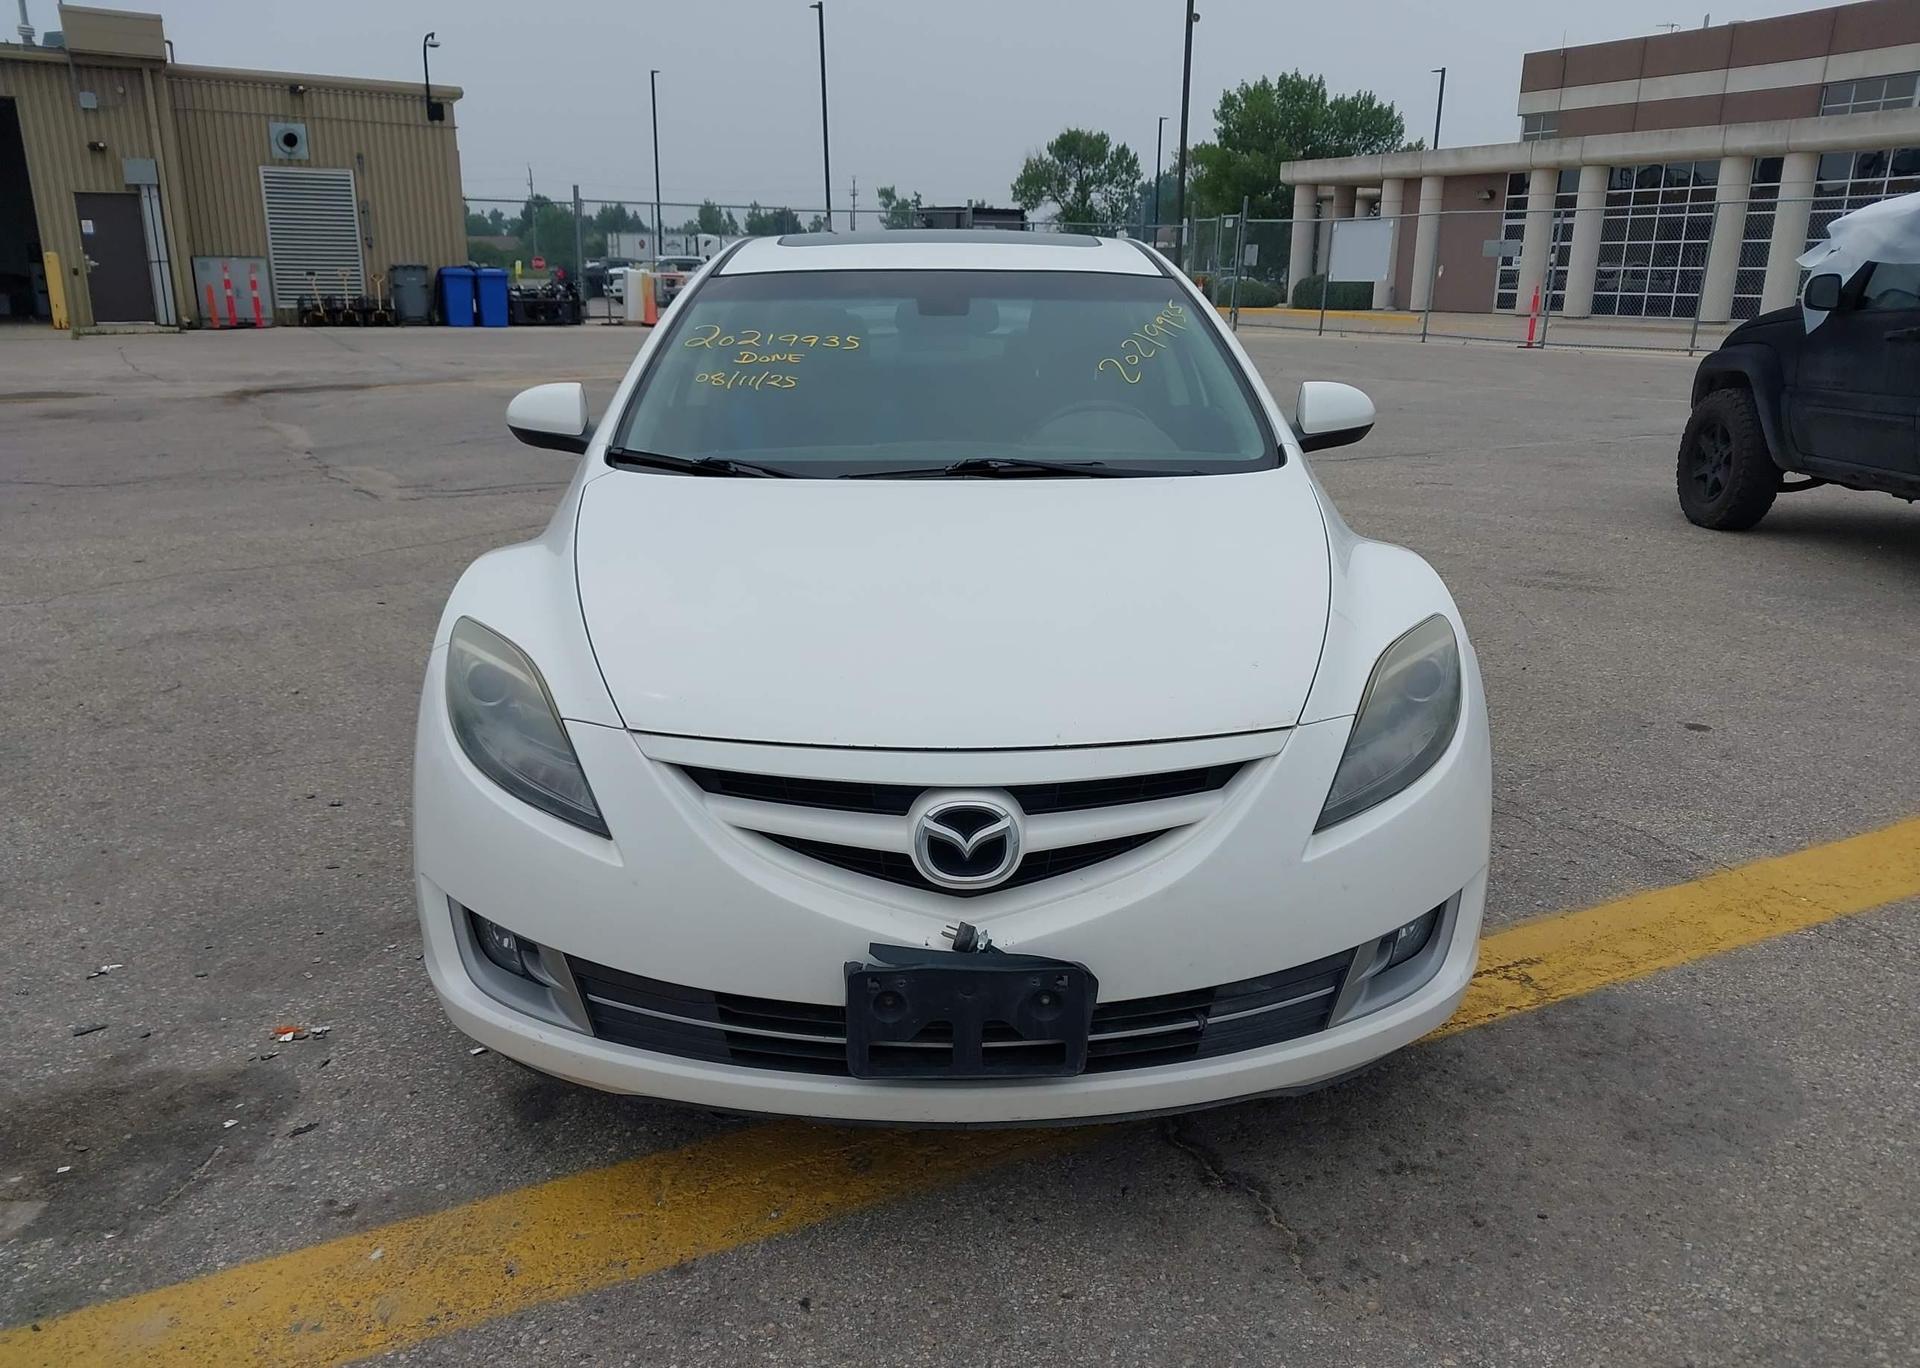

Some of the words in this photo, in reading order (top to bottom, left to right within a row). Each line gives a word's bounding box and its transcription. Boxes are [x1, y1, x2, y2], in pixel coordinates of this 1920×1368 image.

[684, 324, 861, 350] 20219935
[733, 351, 804, 364] DONE
[695, 371, 798, 390] 08/11/25
